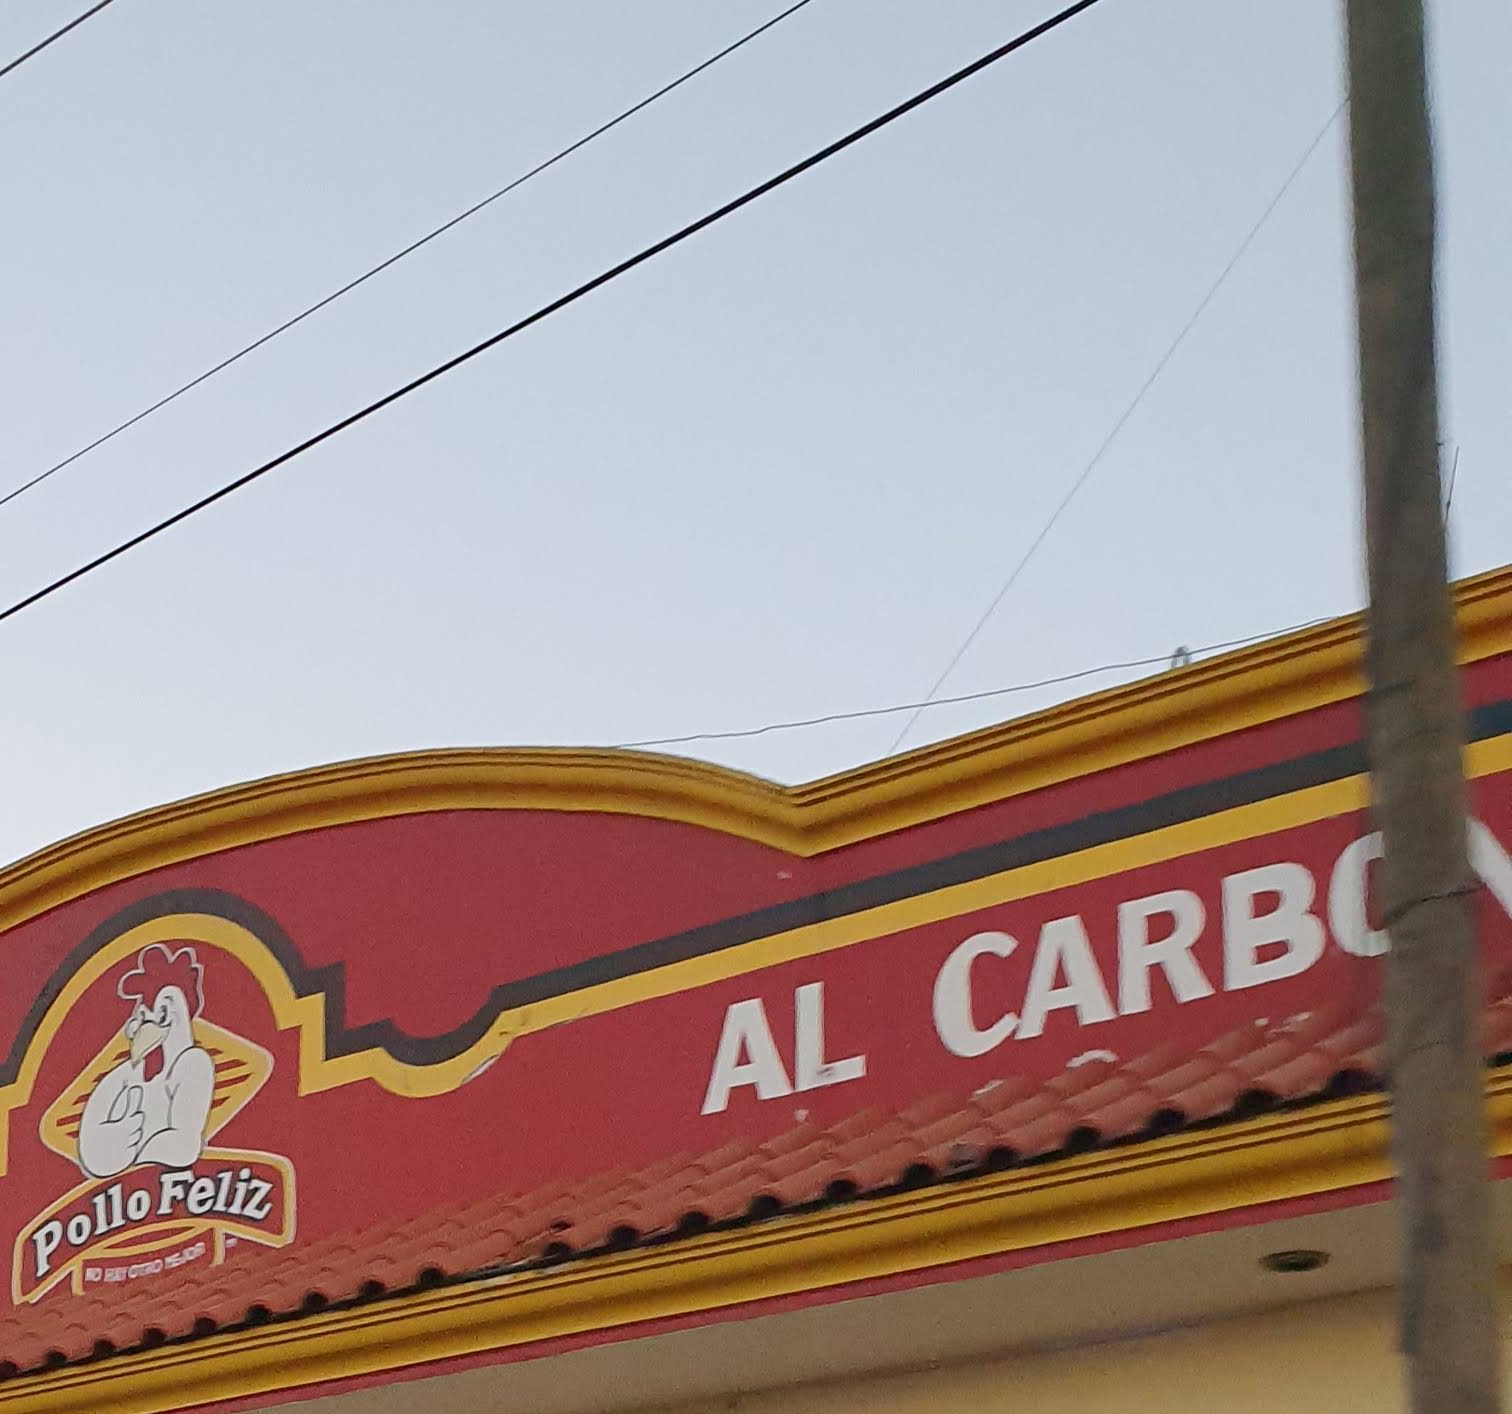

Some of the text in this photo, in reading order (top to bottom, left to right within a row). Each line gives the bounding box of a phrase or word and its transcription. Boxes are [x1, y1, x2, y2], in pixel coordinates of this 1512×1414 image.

[701, 982, 867, 1116] AL
[32, 1167, 274, 1278] Pollo Feliz
